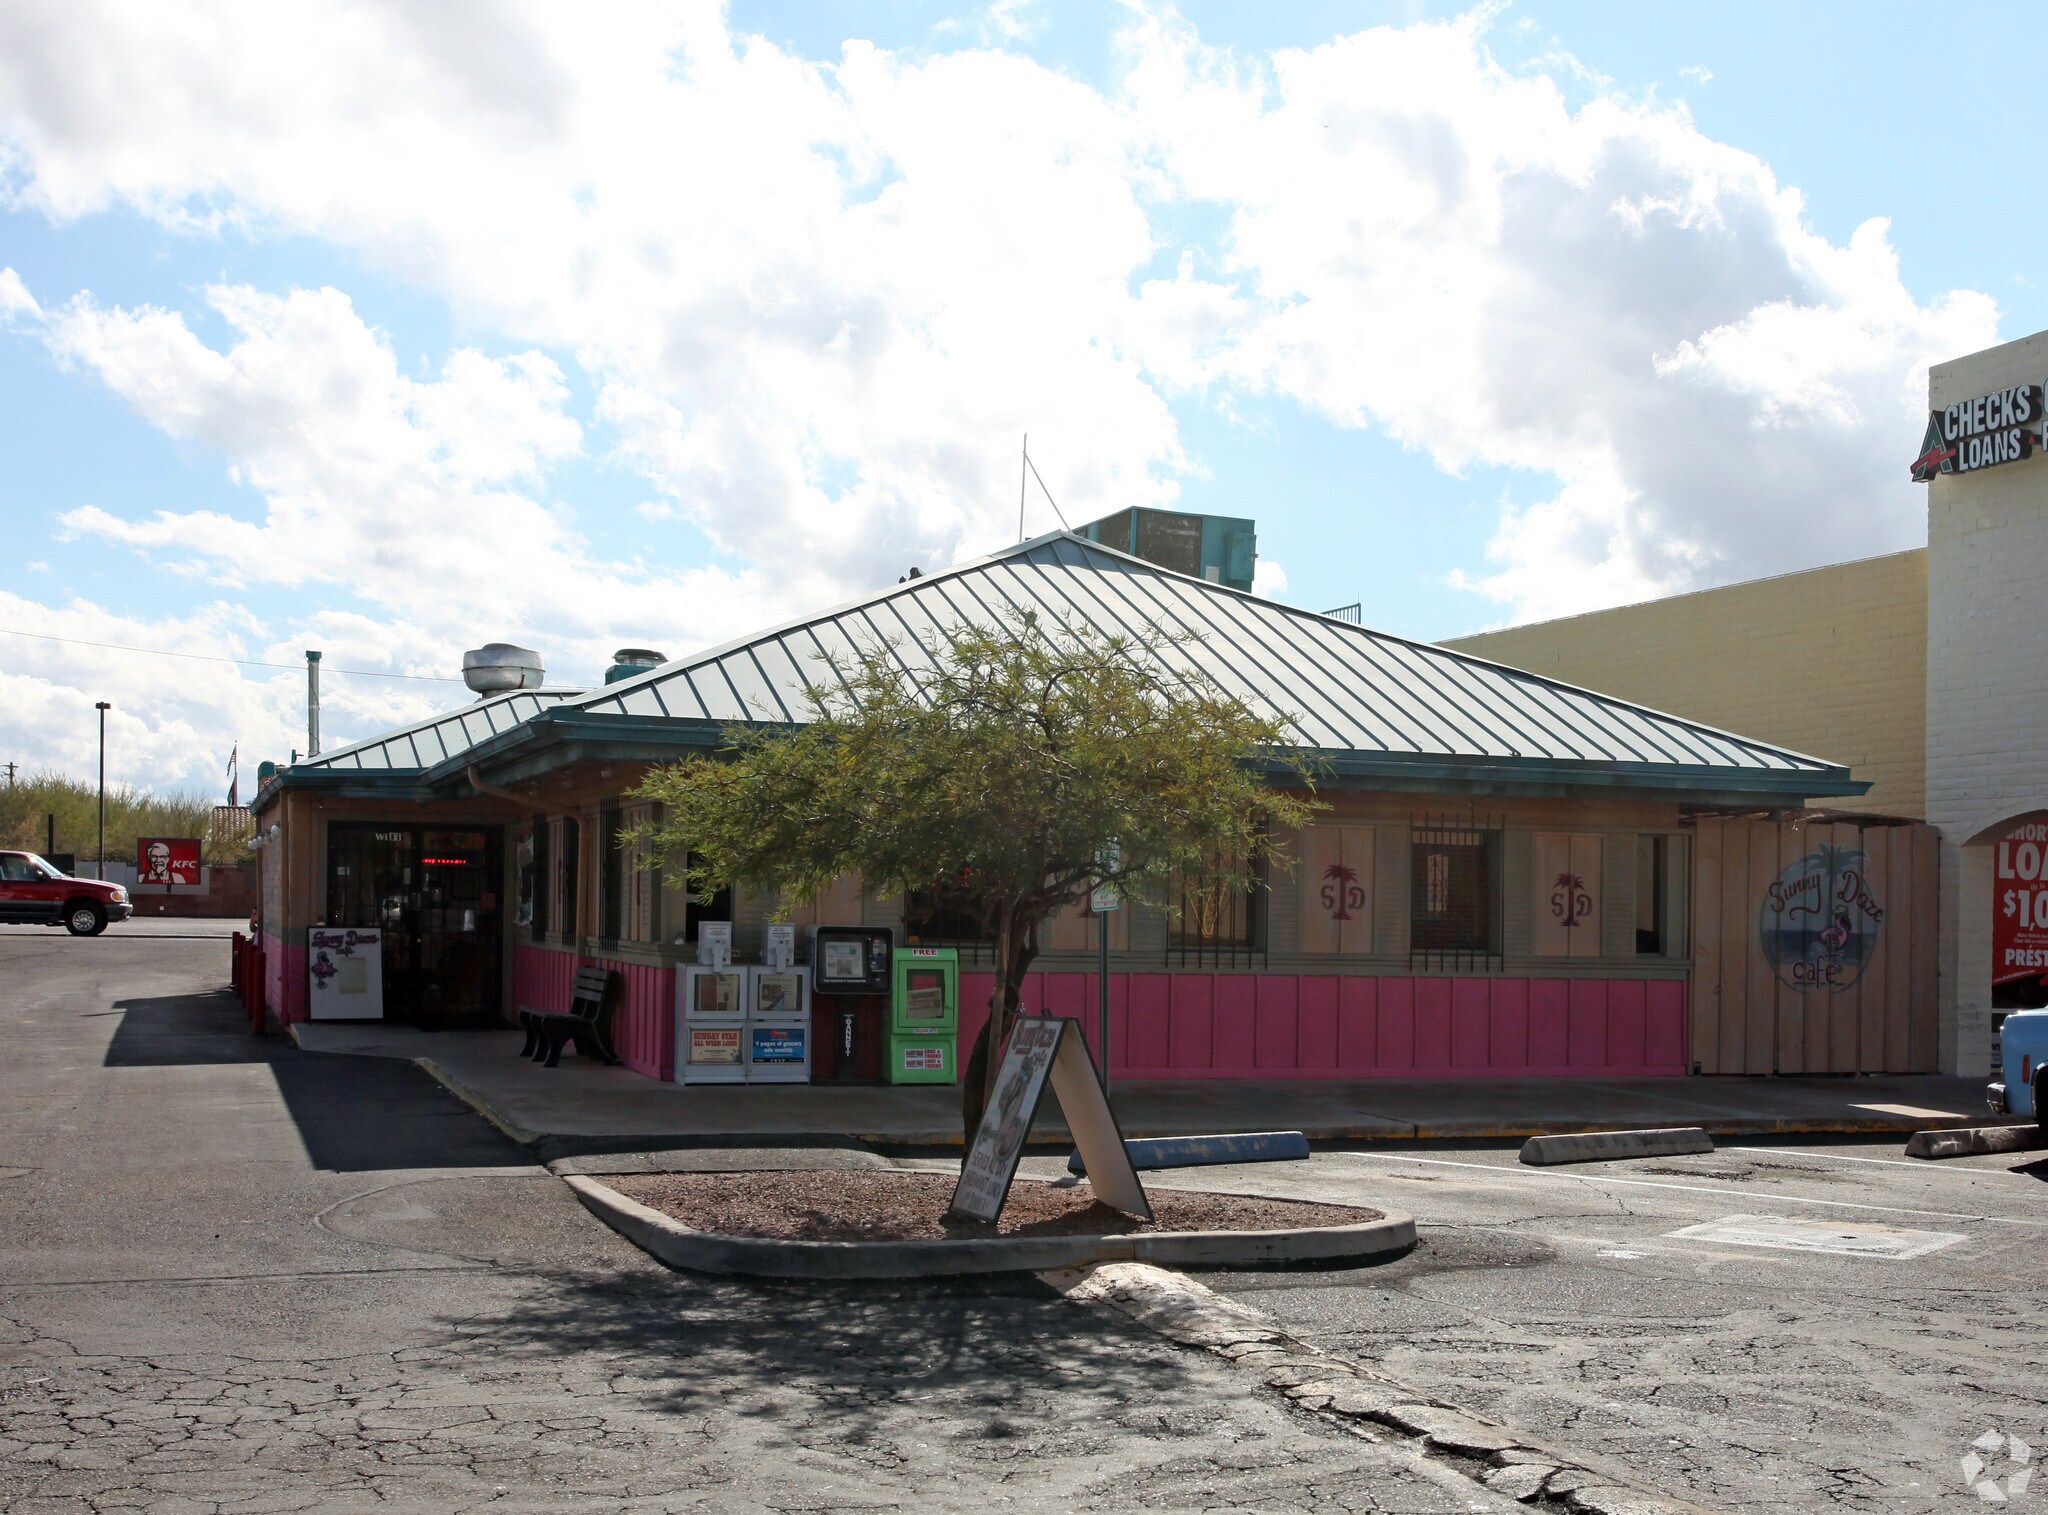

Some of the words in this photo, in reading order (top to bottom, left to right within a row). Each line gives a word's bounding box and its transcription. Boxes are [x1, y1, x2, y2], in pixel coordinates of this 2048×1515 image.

[1944, 384, 2031, 441] CHECKS
[1958, 428, 2021, 472] LOANS
[171, 860, 198, 869] KFC
[1768, 873, 1822, 921] Sunny
[1837, 870, 1884, 923] Daze
